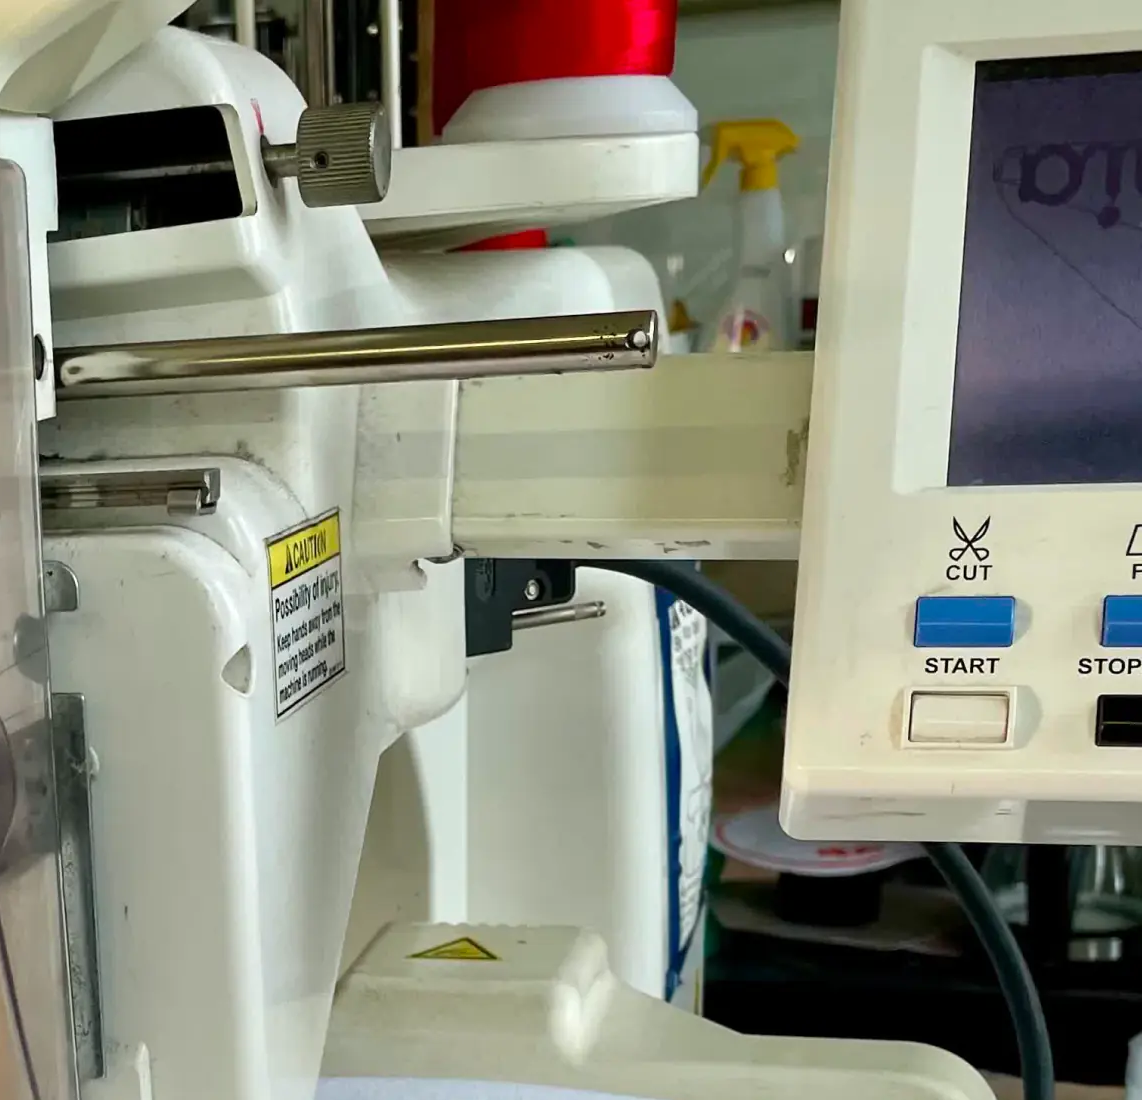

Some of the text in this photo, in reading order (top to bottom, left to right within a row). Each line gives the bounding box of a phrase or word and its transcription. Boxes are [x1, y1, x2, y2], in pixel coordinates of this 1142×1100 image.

[293, 528, 327, 569] CAUTION
[946, 565, 993, 581] CUT
[274, 584, 311, 623] Possibility
[312, 575, 319, 601] of
[277, 633, 291, 655] Keep
[291, 619, 307, 645] hands
[278, 654, 298, 679] moving
[924, 657, 1000, 674] START
[1077, 657, 1142, 675] STOP
[279, 677, 302, 704] machine
